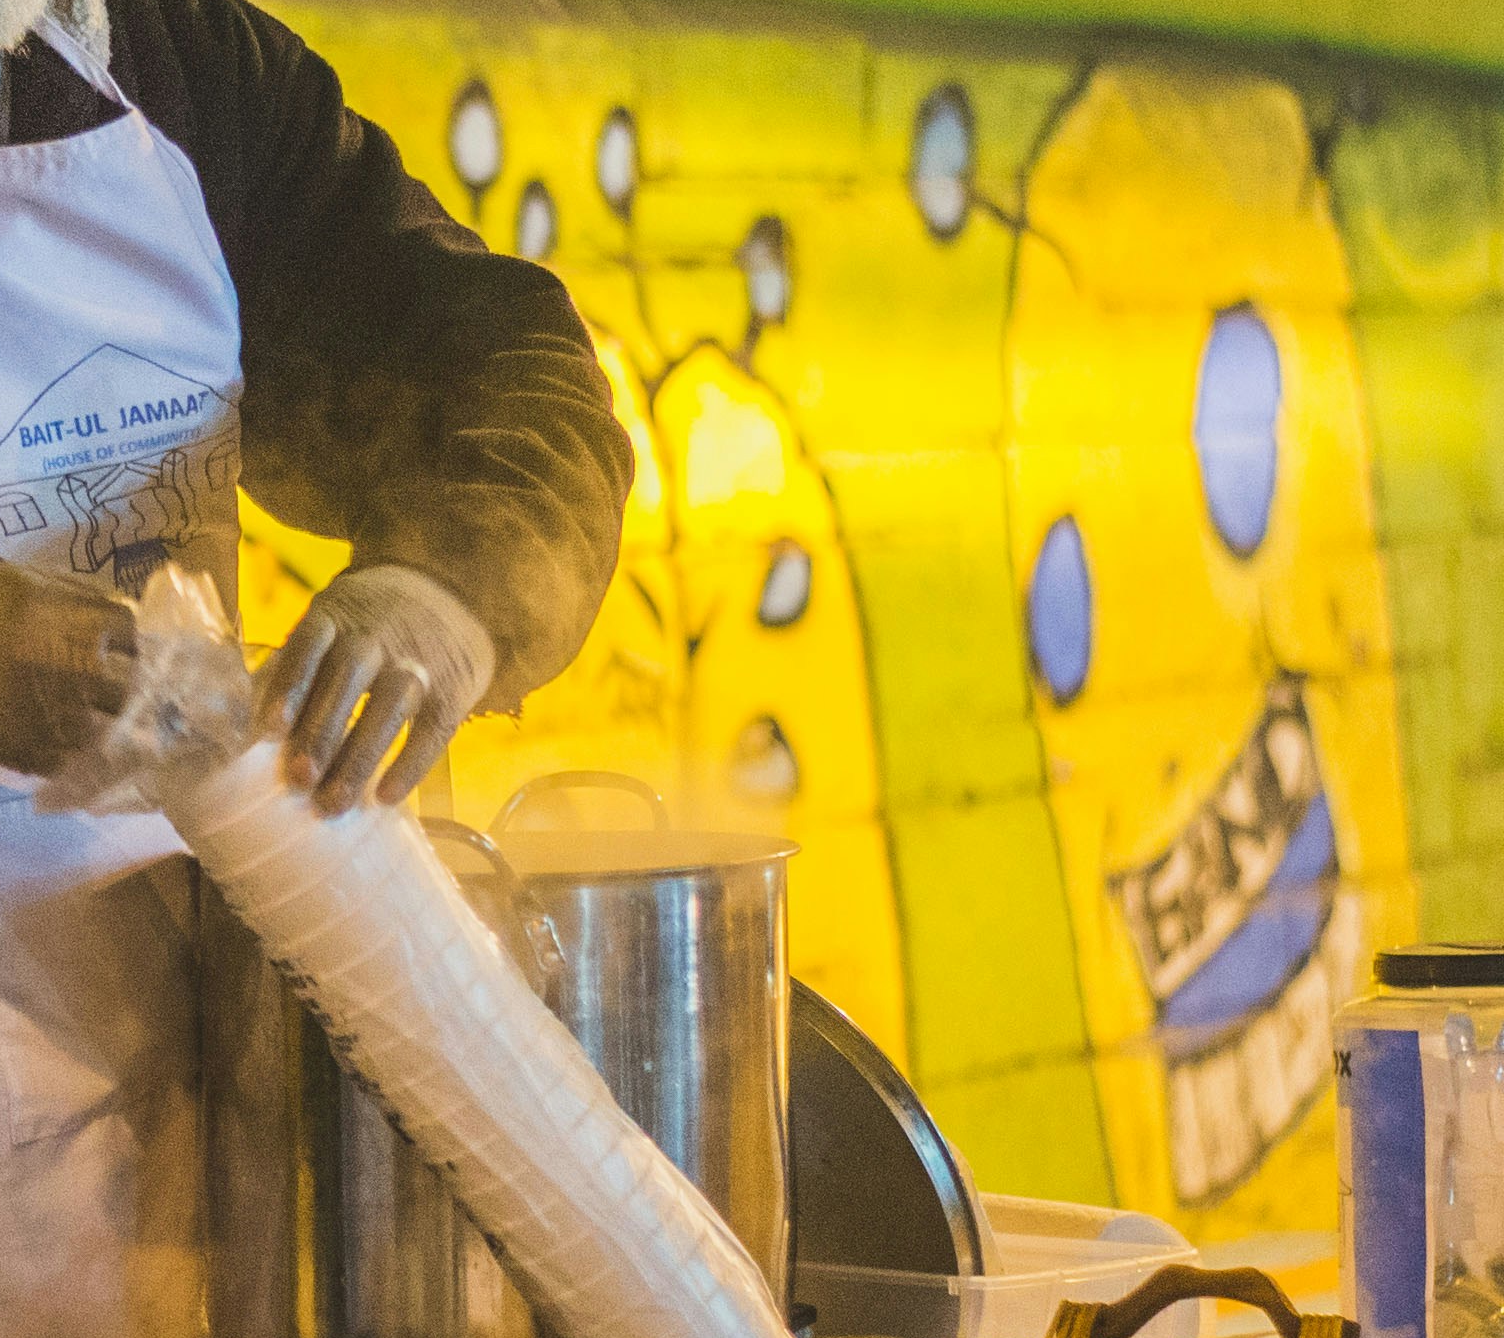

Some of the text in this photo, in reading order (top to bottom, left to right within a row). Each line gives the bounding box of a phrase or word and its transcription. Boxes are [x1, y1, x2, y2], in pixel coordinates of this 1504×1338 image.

[19, 391, 210, 448] BAIT-UL JAMAAT
[96, 446, 115, 460] OF
